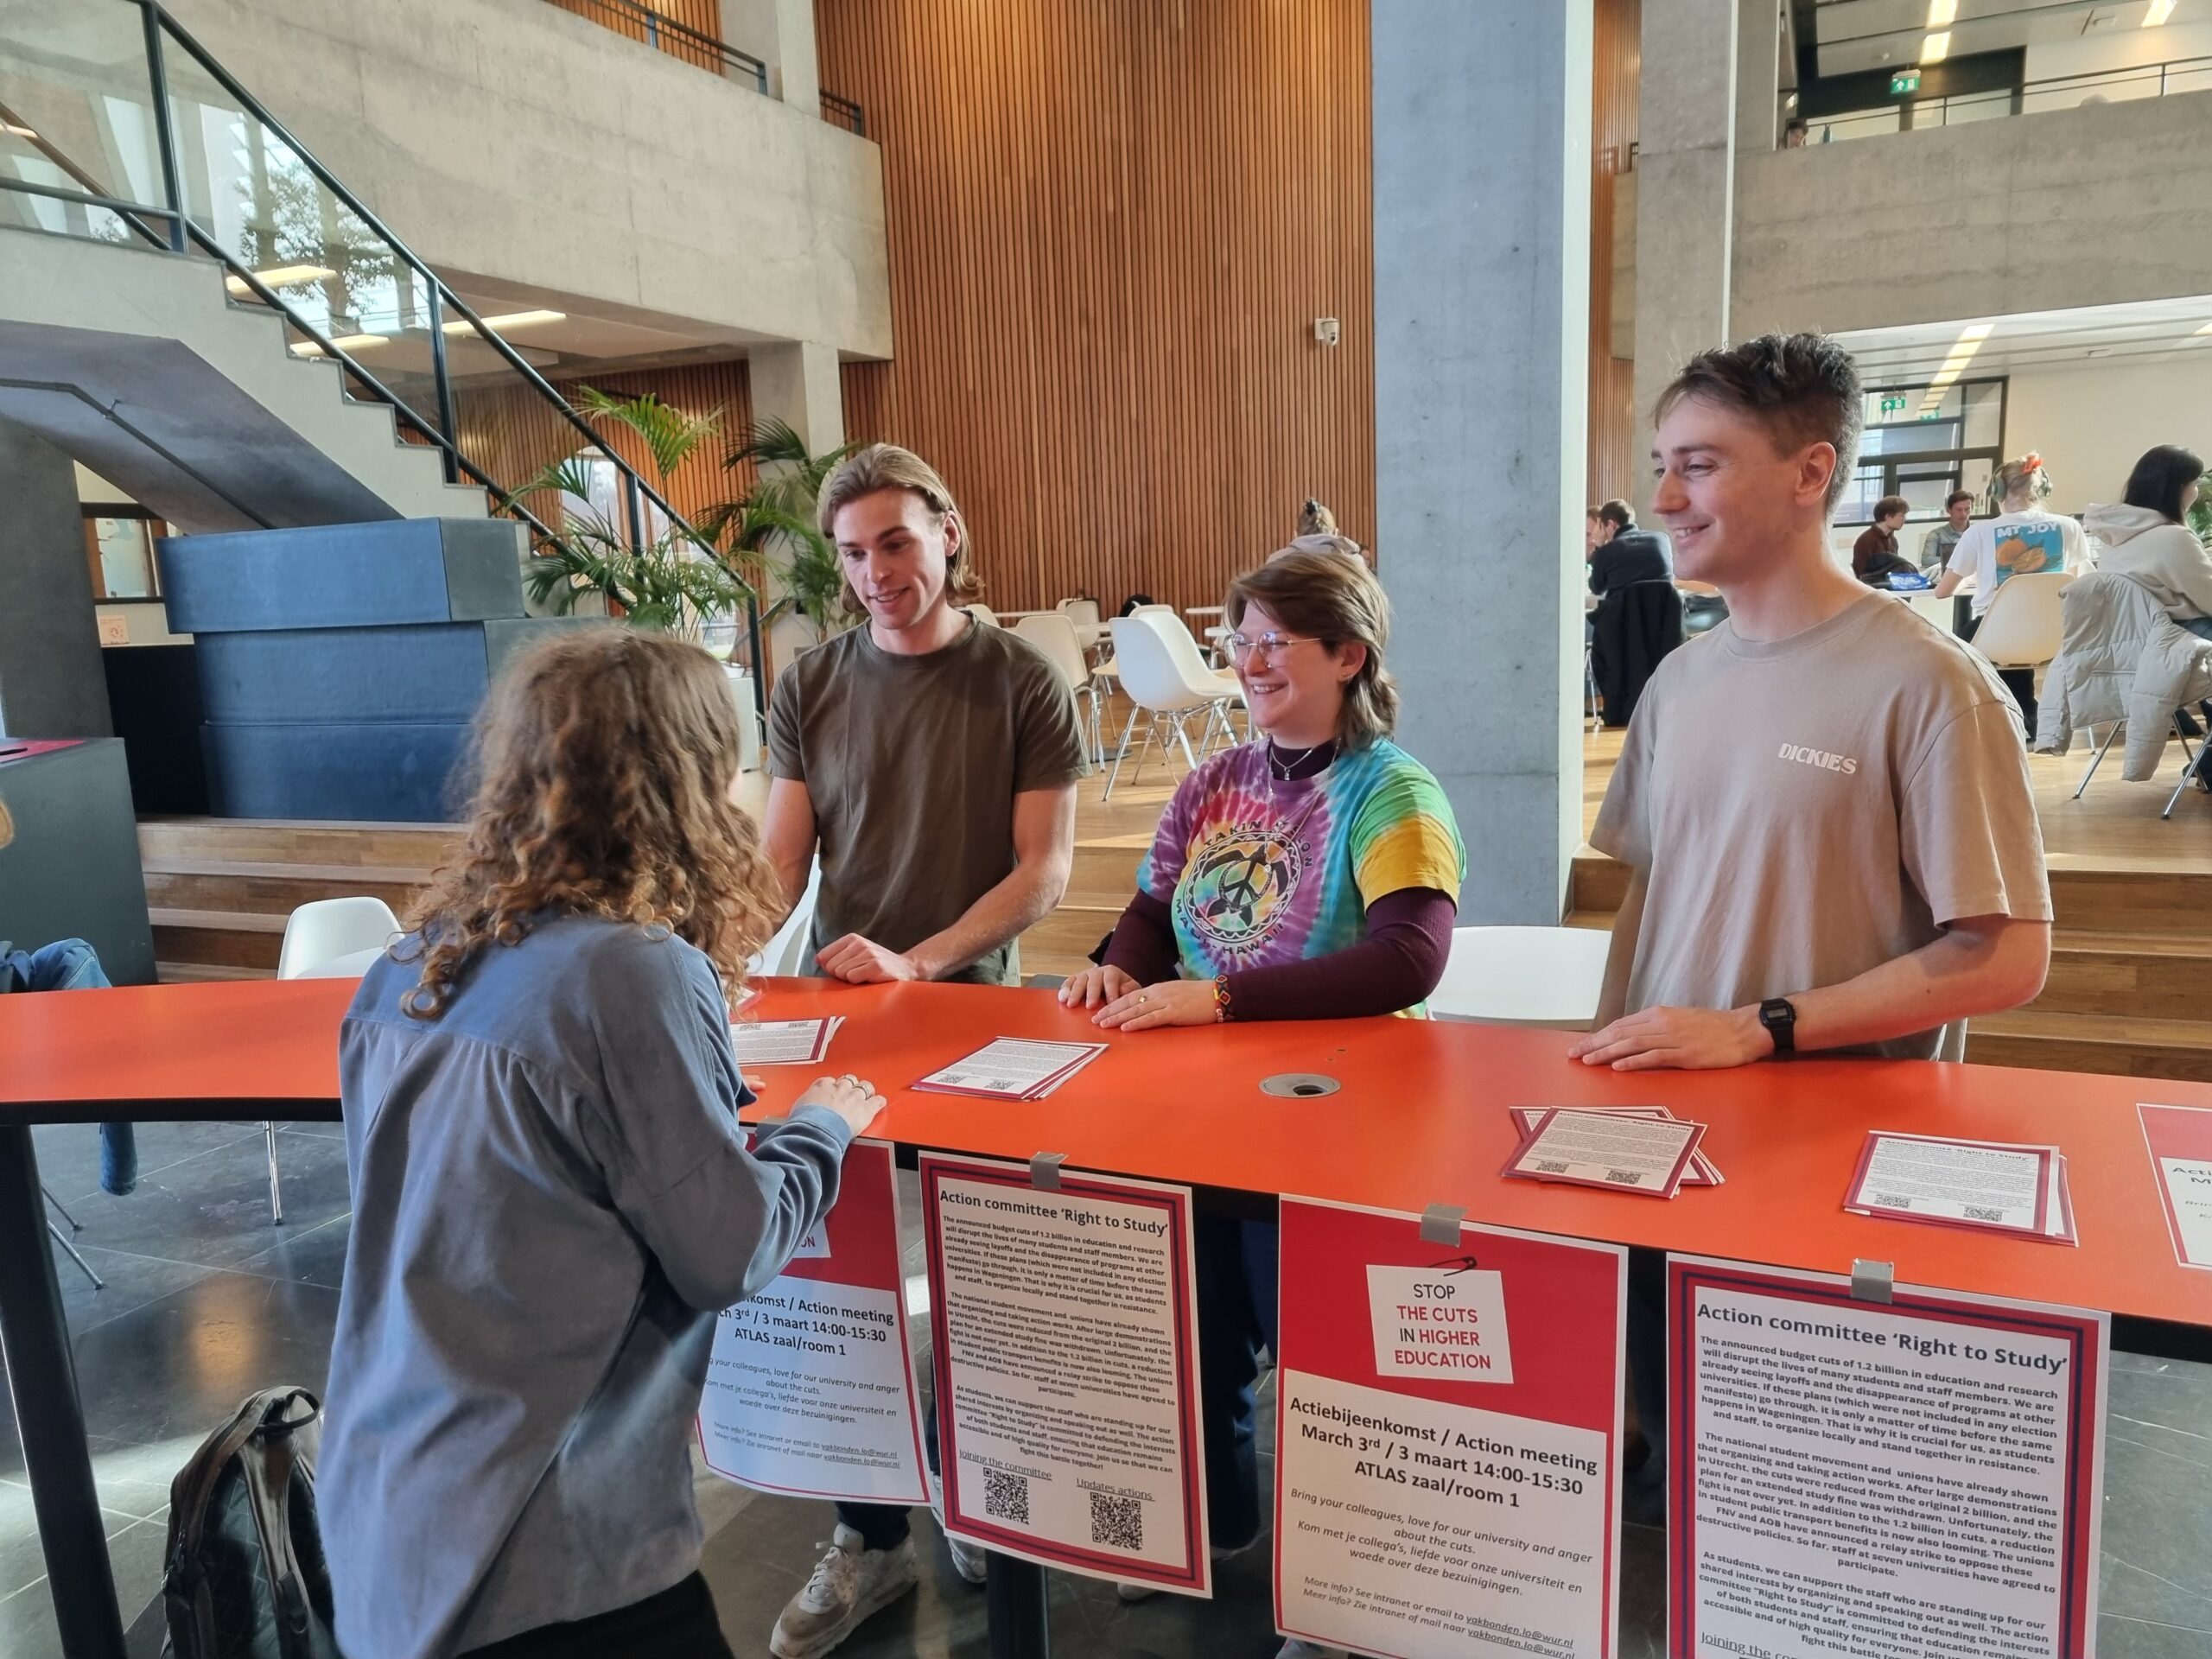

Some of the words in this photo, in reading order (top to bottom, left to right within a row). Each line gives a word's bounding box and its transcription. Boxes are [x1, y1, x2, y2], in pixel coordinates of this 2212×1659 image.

[2027, 522, 2059, 535] JOY
[1777, 742, 1858, 775] DICKIES
[940, 1190, 981, 1206] Action
[984, 1199, 1057, 1218] committee
[1061, 1208, 1101, 1225] ‘Right
[1104, 1215, 1119, 1227] to
[1123, 1217, 1169, 1238] Study’
[1413, 1283, 1457, 1300] STOP
[789, 1296, 794, 1311] /
[798, 1299, 837, 1316] Action
[841, 1308, 893, 1325] meeting
[1395, 1305, 1428, 1322] THE
[1432, 1306, 1478, 1325] CUTS
[734, 1327, 769, 1343] ATLAS
[772, 1335, 835, 1353] zaal/room
[838, 1344, 846, 1355] 1
[753, 1310, 758, 1324] /
[762, 1313, 769, 1324] 3
[772, 1317, 809, 1331] maart
[812, 1320, 886, 1342] 14:00-15:30
[1399, 1326, 1415, 1343] IN
[1418, 1328, 1481, 1347] HIGHER
[1697, 1303, 1762, 1326] Action
[1769, 1317, 1886, 1345] committee
[1892, 1332, 1957, 1357] ‘Right
[1964, 1344, 1986, 1360] to
[1994, 1348, 2069, 1376] Study’
[1394, 1349, 1492, 1370] EDUCATION
[1700, 1335, 1719, 1344] The
[1720, 1340, 1777, 1354] announced
[1779, 1348, 1815, 1361] budget
[1818, 1356, 1840, 1365] cuts
[1857, 1361, 1872, 1370] 1.2
[1874, 1363, 1908, 1376] billion
[1911, 1369, 1921, 1378] in
[1924, 1372, 1980, 1388] education
[1983, 1382, 2005, 1391] and
[2007, 1386, 2057, 1399] research
[732, 1362, 772, 1375] colleagues,
[773, 1367, 789, 1377] love
[791, 1370, 802, 1380] for
[818, 1376, 856, 1389] university
[875, 1385, 899, 1394] anger
[766, 1378, 787, 1389] about
[789, 1382, 803, 1391] the
[1038, 1386, 1076, 1397] participate.
[739, 1399, 762, 1408] woede
[782, 1406, 799, 1414] deze
[800, 1408, 856, 1423] bezuinigingen.
[778, 1392, 798, 1402] liefde
[819, 1401, 838, 1409] onze
[840, 1403, 884, 1415] universiteit
[1290, 1397, 1436, 1441] Actiebijeenkomst
[1440, 1428, 1450, 1446] /
[1455, 1433, 1513, 1456] Action
[1520, 1448, 1597, 1475] meeting
[959, 1449, 988, 1465] Joining
[988, 1456, 1003, 1467] the
[1004, 1460, 1052, 1480] committee
[1301, 1423, 1352, 1448] March
[1385, 1441, 1394, 1459] /
[1399, 1446, 1408, 1459] 3
[1414, 1452, 1467, 1472] maart
[1473, 1460, 1582, 1494] 14:00-15:30
[1076, 1477, 1116, 1494] Updates
[1117, 1487, 1154, 1500] actions
[1354, 1460, 1406, 1484] ATLAS
[1412, 1475, 1503, 1503] zaal/room
[1510, 1492, 1519, 1507] 1
[1291, 1488, 1317, 1504] Bring
[1319, 1497, 1344, 1508] your
[1345, 1503, 1403, 1524] colleagues,
[1408, 1515, 1430, 1528] love
[1432, 1520, 1450, 1532] for
[1452, 1527, 1471, 1536] our
[1474, 1531, 1529, 1551] university
[1532, 1544, 1555, 1554] and
[1557, 1549, 1592, 1562] anger
[1297, 1520, 1319, 1533] Kom
[1323, 1528, 1344, 1539] met
[1344, 1531, 1356, 1542] je
[1410, 1545, 1440, 1560] liefde
[1443, 1555, 1469, 1567] voor
[1471, 1561, 1497, 1573] onze
[1500, 1568, 1565, 1589] universiteit
[1567, 1584, 1581, 1593] en
[1394, 1529, 1426, 1542] about
[1429, 1535, 1446, 1547] the
[1449, 1541, 1475, 1554] cuts.
[1350, 1549, 1384, 1563] woede
[1388, 1558, 1411, 1568] over
[1414, 1562, 1439, 1575] deze
[1441, 1568, 1522, 1595] bezuinigingen.
[1838, 1558, 1897, 1576] participate.
[1303, 1588, 1326, 1599] Meer
[1328, 1594, 1351, 1605] info?
[1353, 1599, 1366, 1609] Zie
[1369, 1604, 1406, 1618] intranet
[1408, 1614, 1419, 1623] of
[1420, 1618, 1441, 1627] mail
[1442, 1623, 1465, 1633] naar
[1304, 1576, 1328, 1588] More
[1331, 1583, 1353, 1593] info?
[1355, 1587, 1371, 1598] See
[1373, 1592, 1410, 1607] intranet
[1425, 1606, 1452, 1618] email
[1453, 1611, 1464, 1620] to
[1466, 1616, 1573, 1649] vakbonden.lo@wur.nl
[1700, 1631, 1746, 1650] Joining
